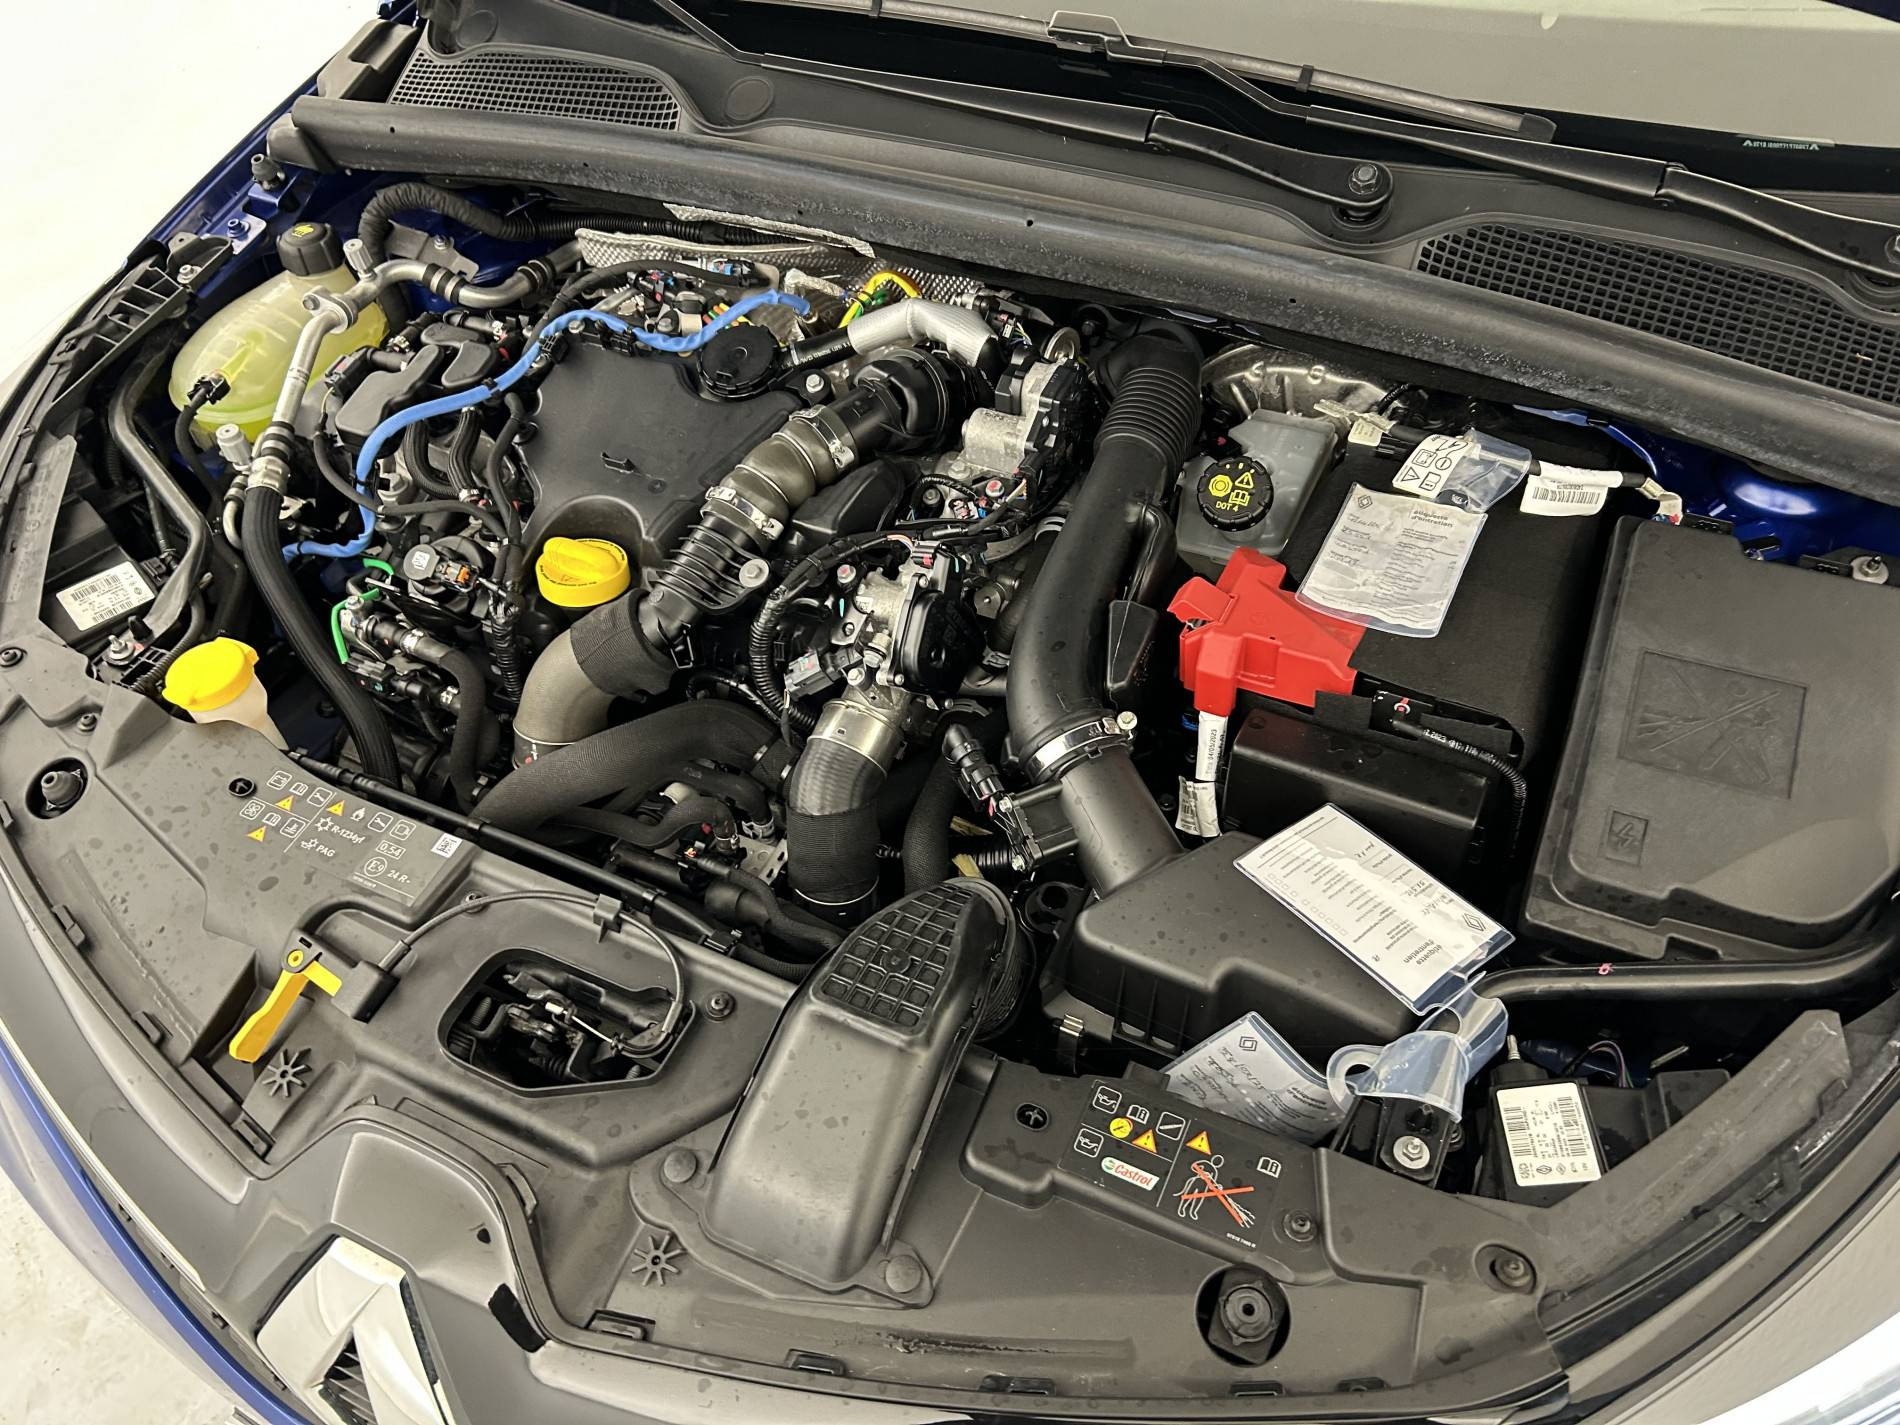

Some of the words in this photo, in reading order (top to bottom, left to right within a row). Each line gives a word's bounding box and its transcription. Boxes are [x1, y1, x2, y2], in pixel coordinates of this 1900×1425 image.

[1215, 501, 1232, 511] DOT
[330, 825, 366, 844] R-1234yf
[316, 843, 336, 858] PAG
[380, 842, 401, 857] 0,54
[387, 869, 398, 880] 24
[1114, 1164, 1153, 1187] Castrol
